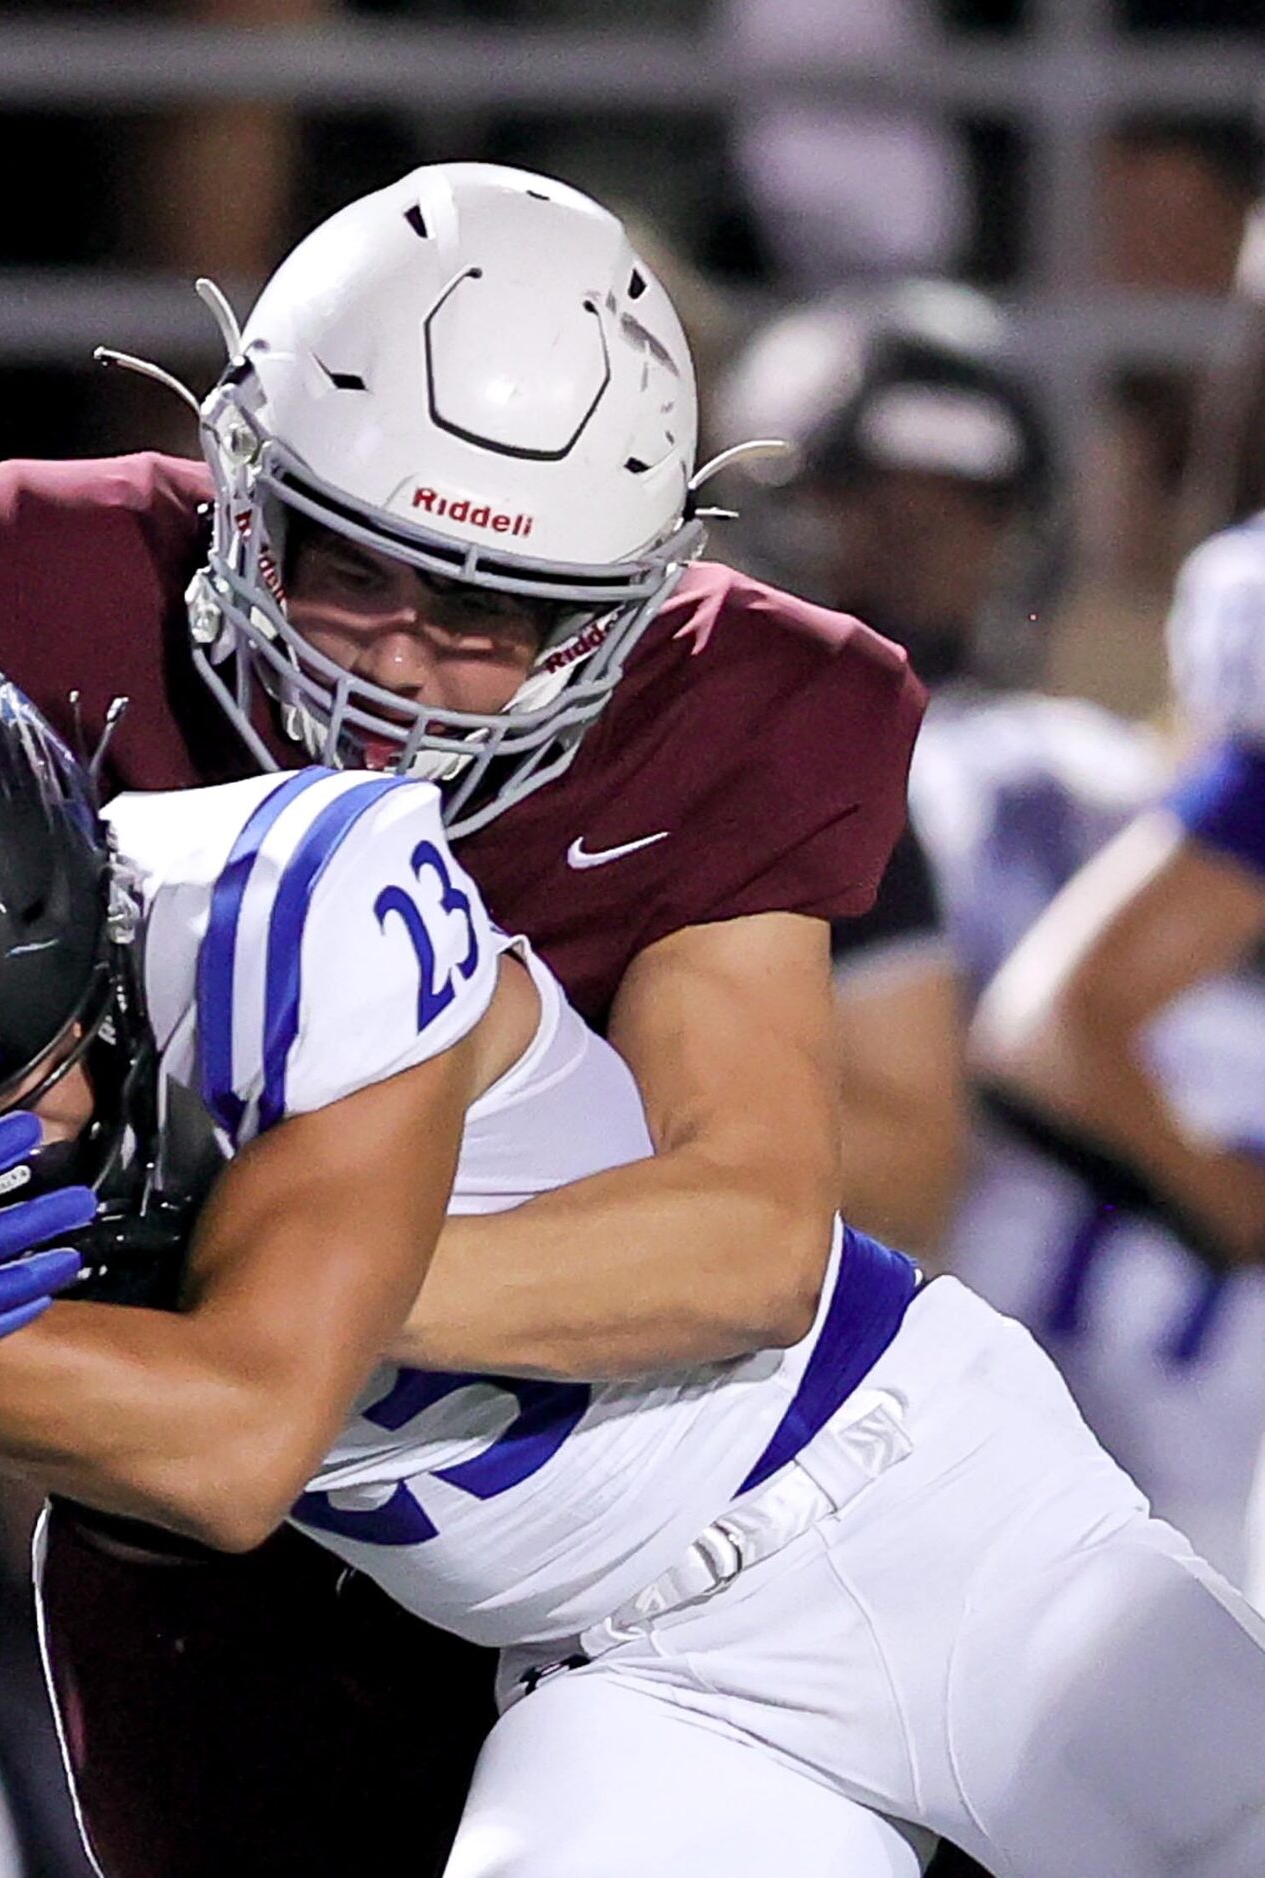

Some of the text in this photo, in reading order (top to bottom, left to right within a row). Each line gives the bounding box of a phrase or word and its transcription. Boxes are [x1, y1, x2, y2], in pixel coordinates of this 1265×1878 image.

[412, 487, 534, 539] Riddell
[544, 617, 617, 675] Ridd
[373, 840, 479, 1036] 23
